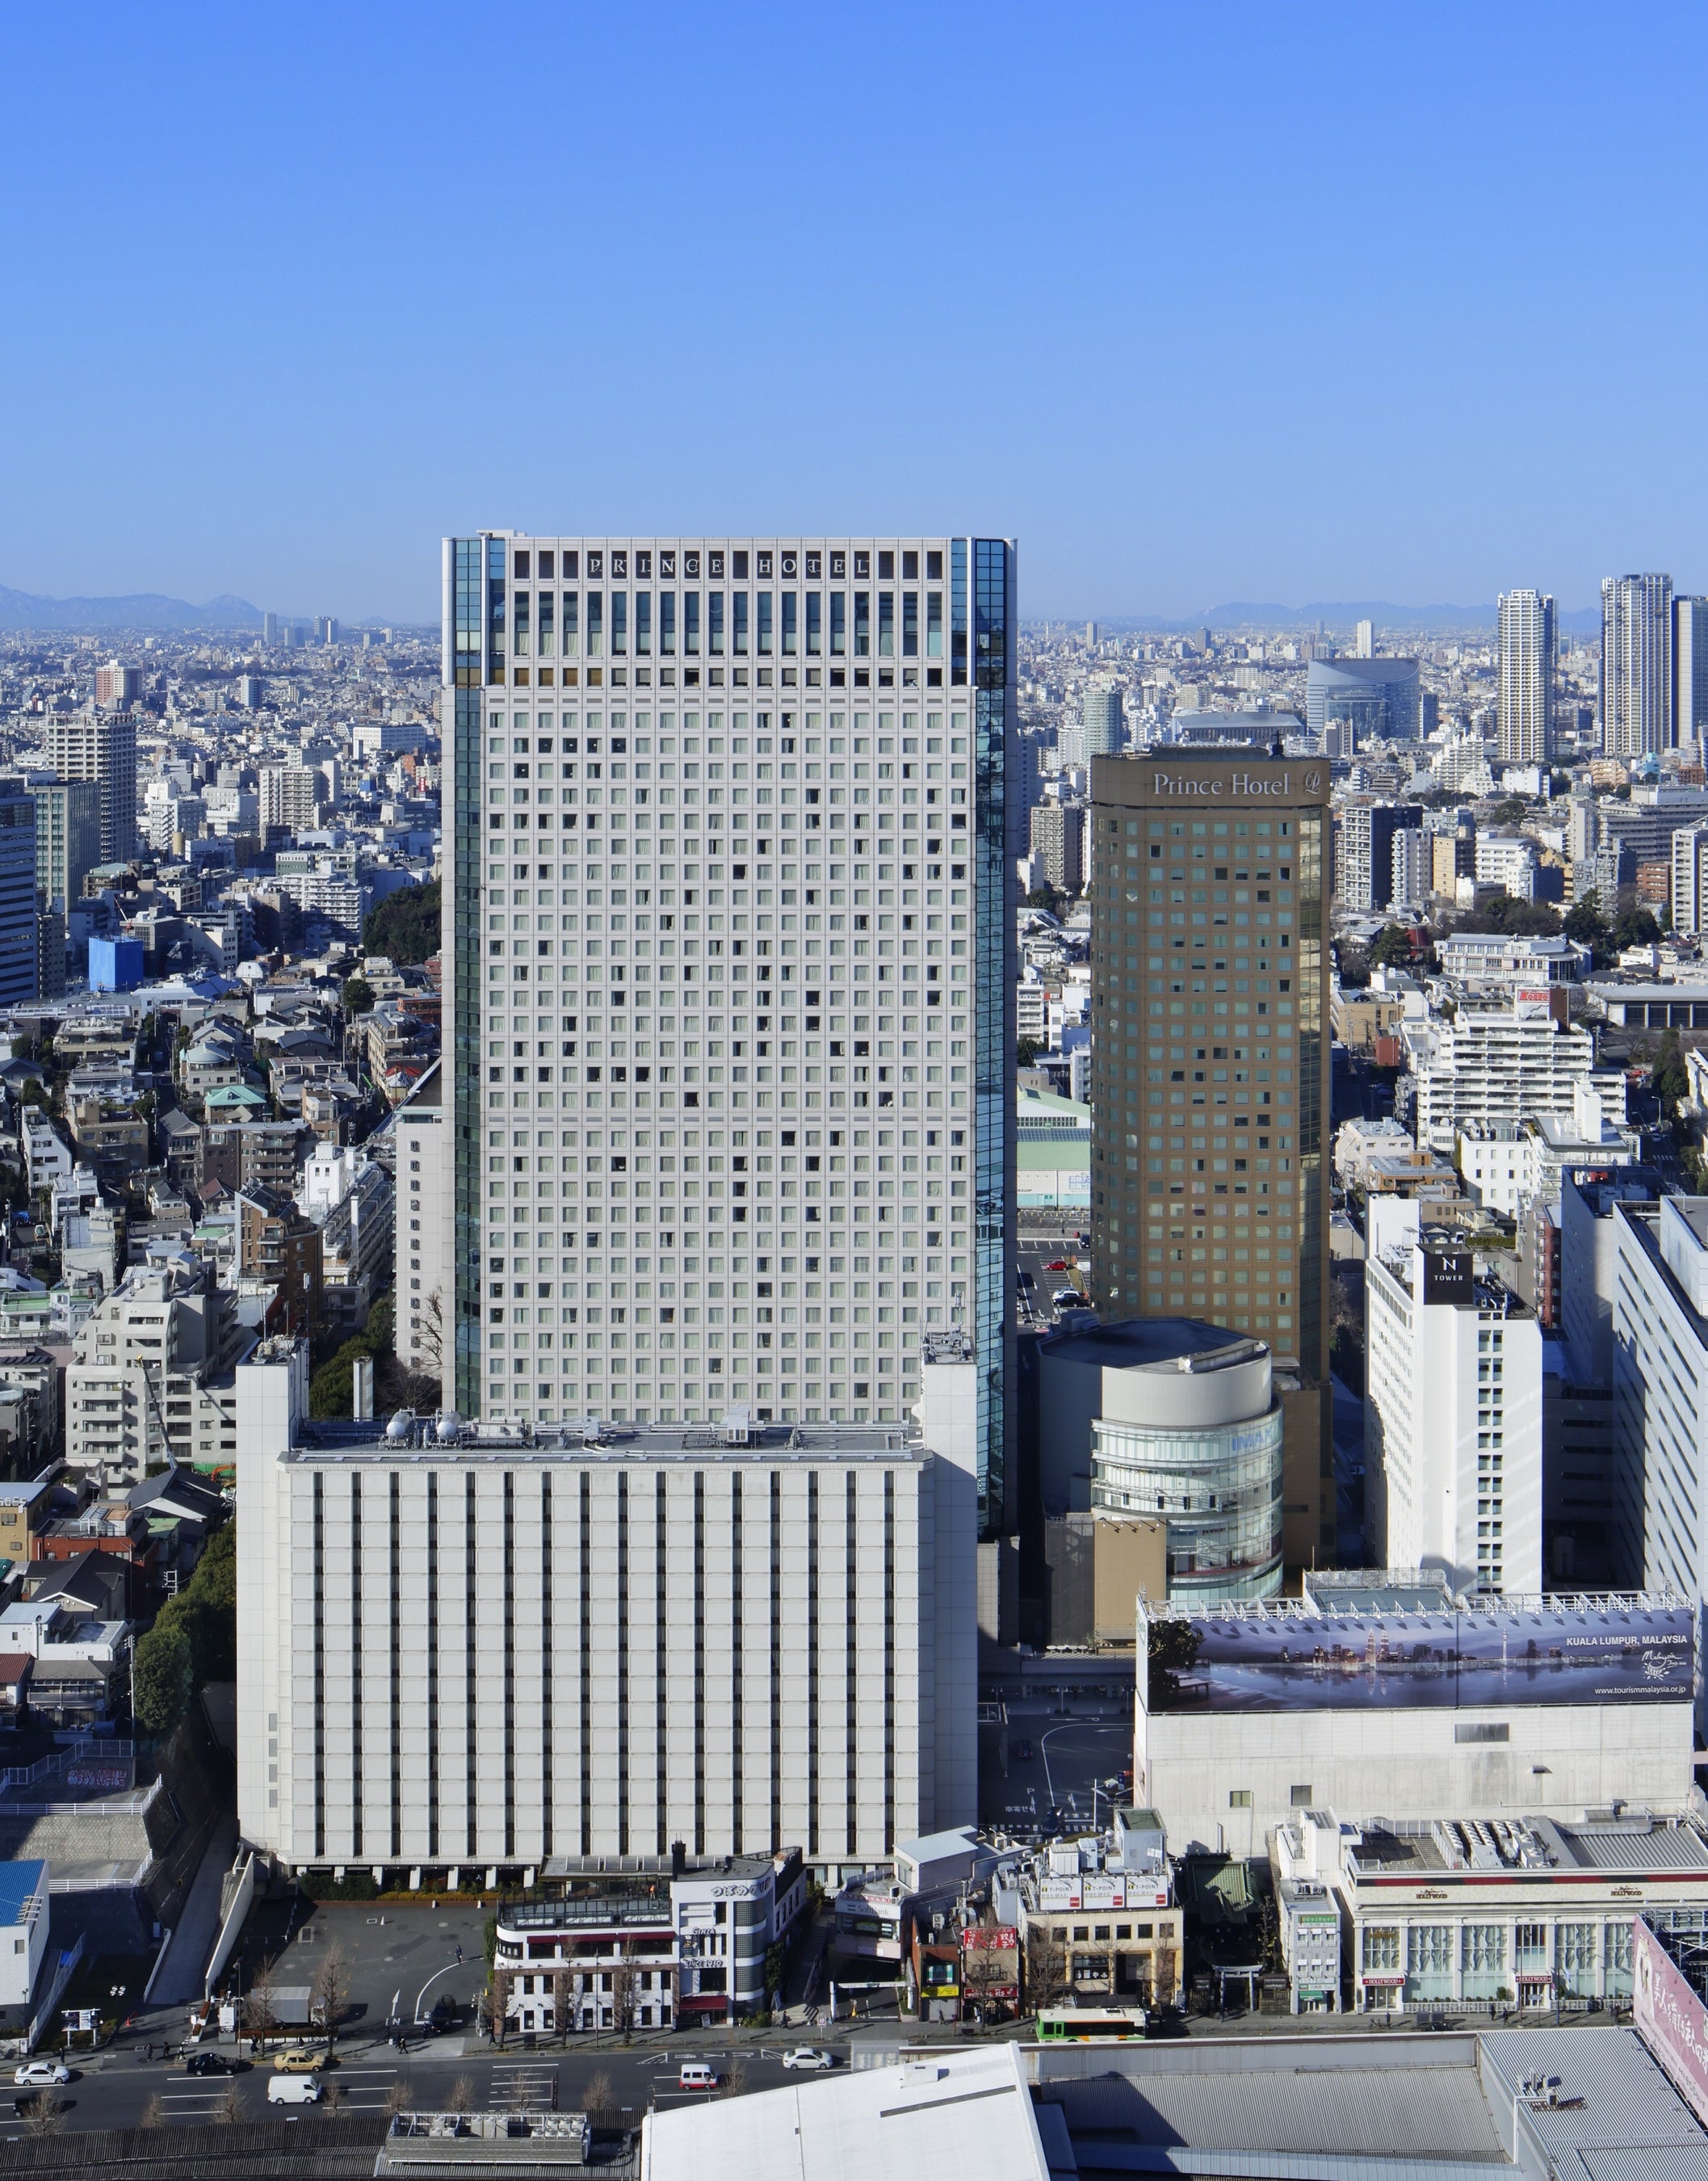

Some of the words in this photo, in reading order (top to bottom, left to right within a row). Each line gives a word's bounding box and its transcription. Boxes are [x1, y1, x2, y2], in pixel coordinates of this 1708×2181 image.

[590, 558, 724, 573] PRINCE
[758, 558, 869, 573] HOTEL
[1153, 773, 1223, 795] Prince
[1231, 771, 1290, 795] Hotel
[1442, 1257, 1457, 1271] N
[1567, 1637, 1597, 1645] KUALA
[1600, 1636, 1639, 1645] LUMPUR,
[1642, 1635, 1687, 1644] MALAYSIA
[1594, 1686, 1686, 1695] www.tourismmalaysia.or.jp
[858, 1906, 889, 1915] SoftBank
[694, 1927, 716, 1935] GINZA
[385, 2017, 401, 2026] IN
